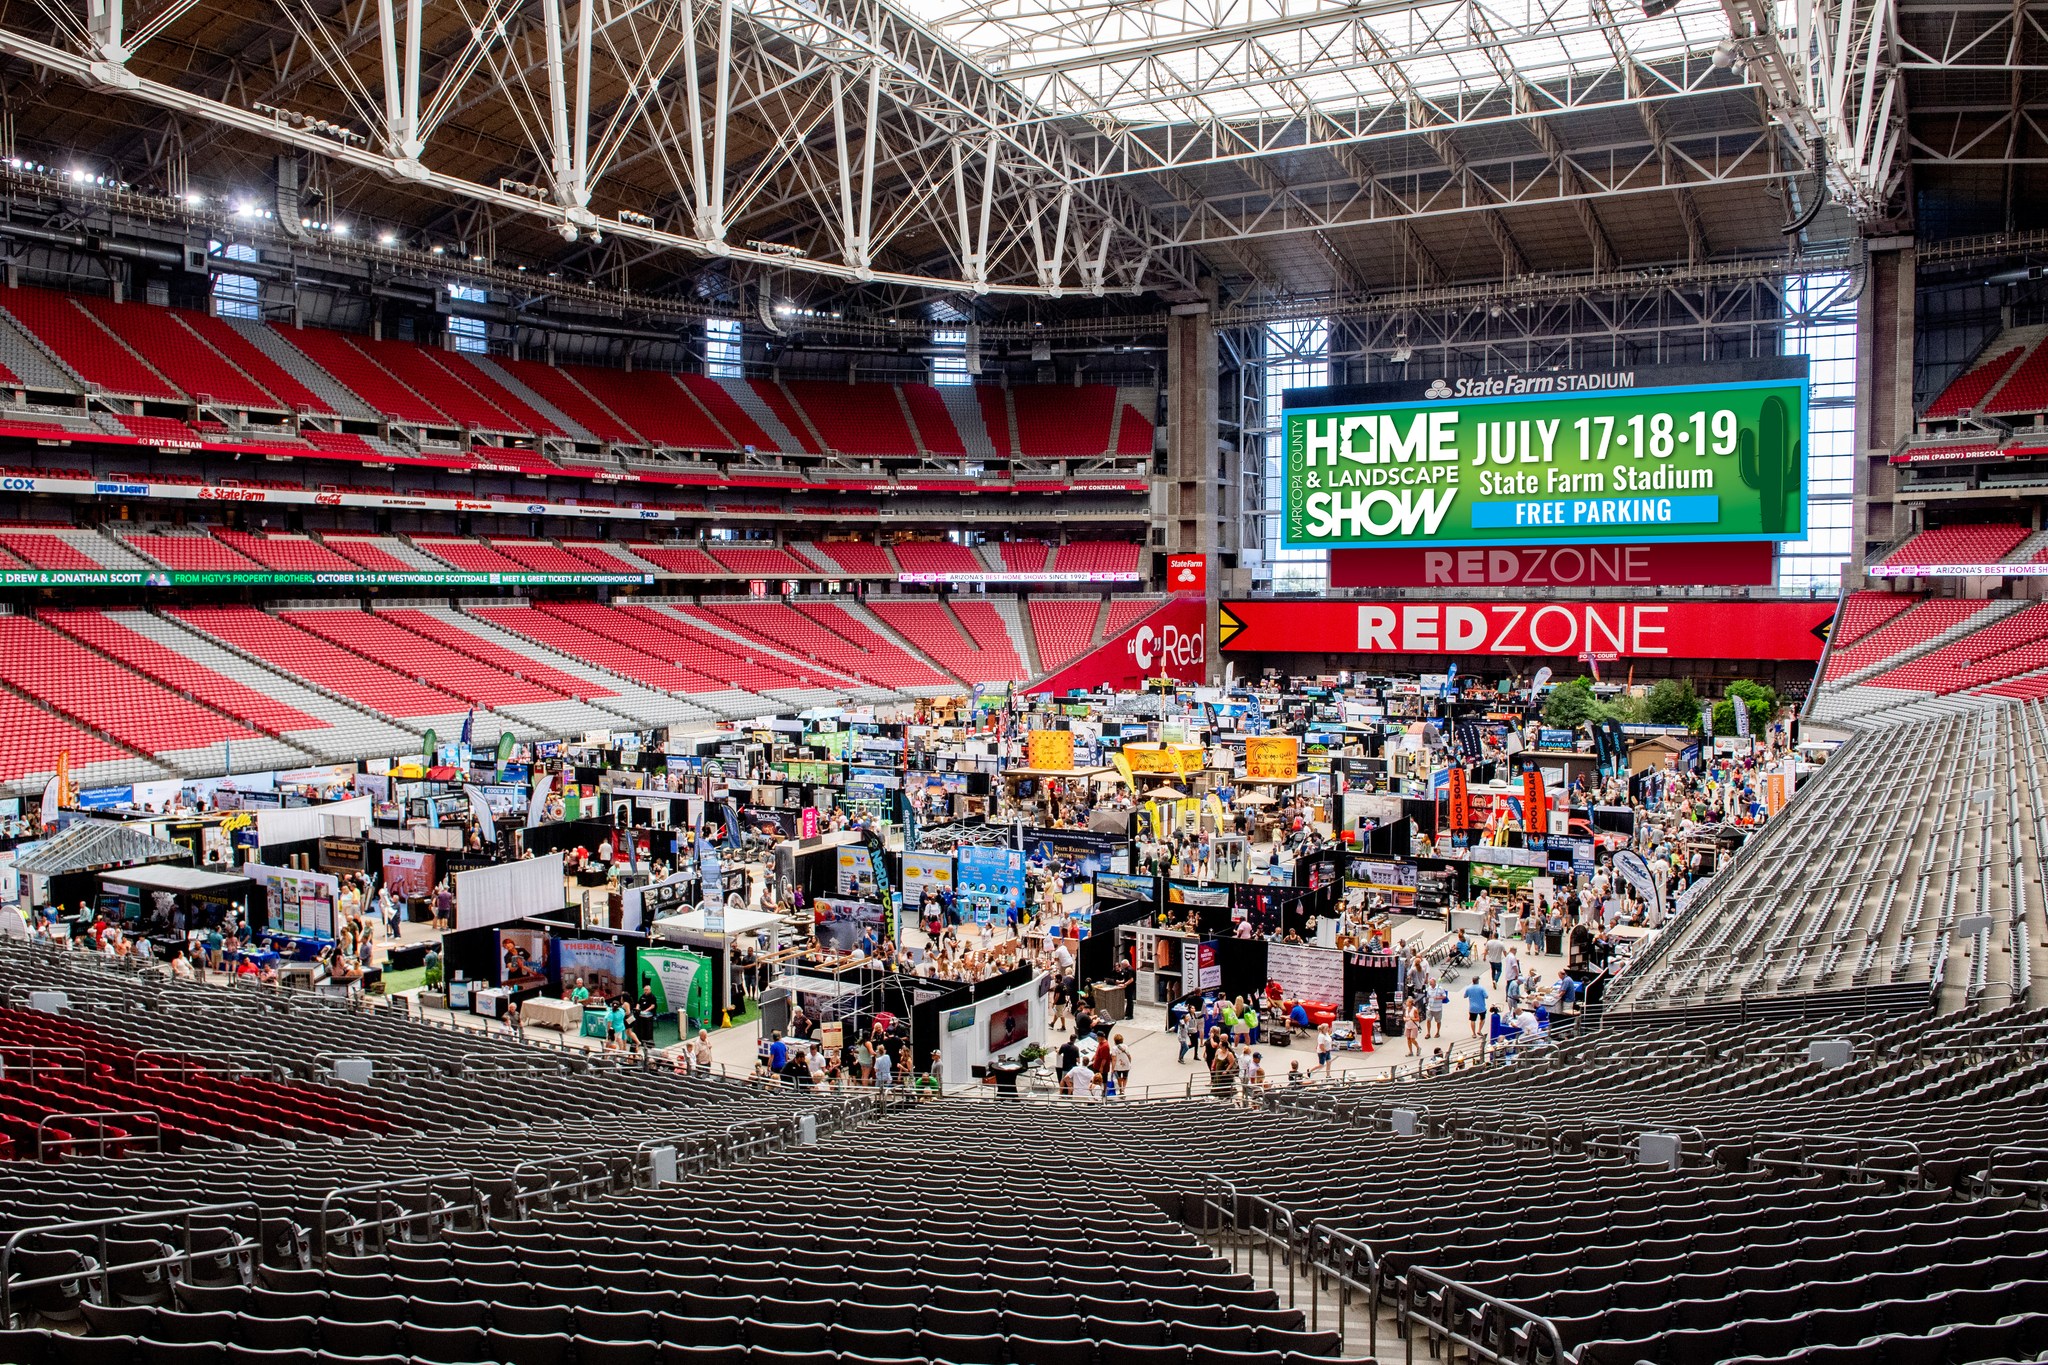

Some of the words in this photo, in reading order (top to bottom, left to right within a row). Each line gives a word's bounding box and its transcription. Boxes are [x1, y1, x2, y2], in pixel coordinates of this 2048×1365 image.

[1557, 372, 1634, 391] STADIUM
[166, 440, 202, 449] TILLMAN
[1292, 420, 1303, 474] COUNTY
[1472, 418, 1561, 466] JULY
[1931, 453, 1964, 461] (PADDY)
[1966, 450, 2005, 458] DRISCOLL
[478, 463, 497, 471] ROGER
[3, 478, 35, 490] COX
[1306, 472, 1321, 488] &
[1329, 465, 1459, 487] LANDSCAPE
[1479, 470, 1538, 495] State
[1547, 467, 1604, 493] Farm
[1613, 464, 1713, 491] Stadium
[97, 483, 118, 494] BUD
[119, 484, 148, 495] LIGHT
[1292, 475, 1303, 538] MARICOPA
[1306, 487, 1459, 537] SHOW
[1515, 501, 1565, 524] FREE
[1574, 498, 1671, 523] PARKING
[1425, 547, 1650, 583] REDZONE
[1936, 566, 1982, 574] ARIZONA'S
[6, 573, 38, 583] DREW
[40, 573, 49, 583] &
[50, 573, 107, 583] JONATHAN
[110, 573, 141, 583] SCOTT
[175, 574, 200, 583] FROM
[233, 574, 273, 584] PROPERTY
[316, 574, 354, 583] OCTOBER
[355, 574, 376, 583] 13-15
[377, 574, 387, 583] AT
[387, 574, 433, 583] WESTWORLD
[434, 574, 444, 583] OF
[445, 574, 488, 583] SCOTTSDALE
[502, 575, 520, 583] MEET
[521, 575, 526, 583] &
[527, 575, 548, 583] GREET
[549, 575, 572, 583] TICKETS
[573, 575, 581, 583] AT
[581, 575, 642, 583] MCHOMESHOWS.COM
[1357, 606, 1668, 653] REDZONE
[1597, 652, 1618, 660] COURT
[1528, 773, 1536, 799] SOLAR
[1068, 846, 1096, 854] ELECTRICAL
